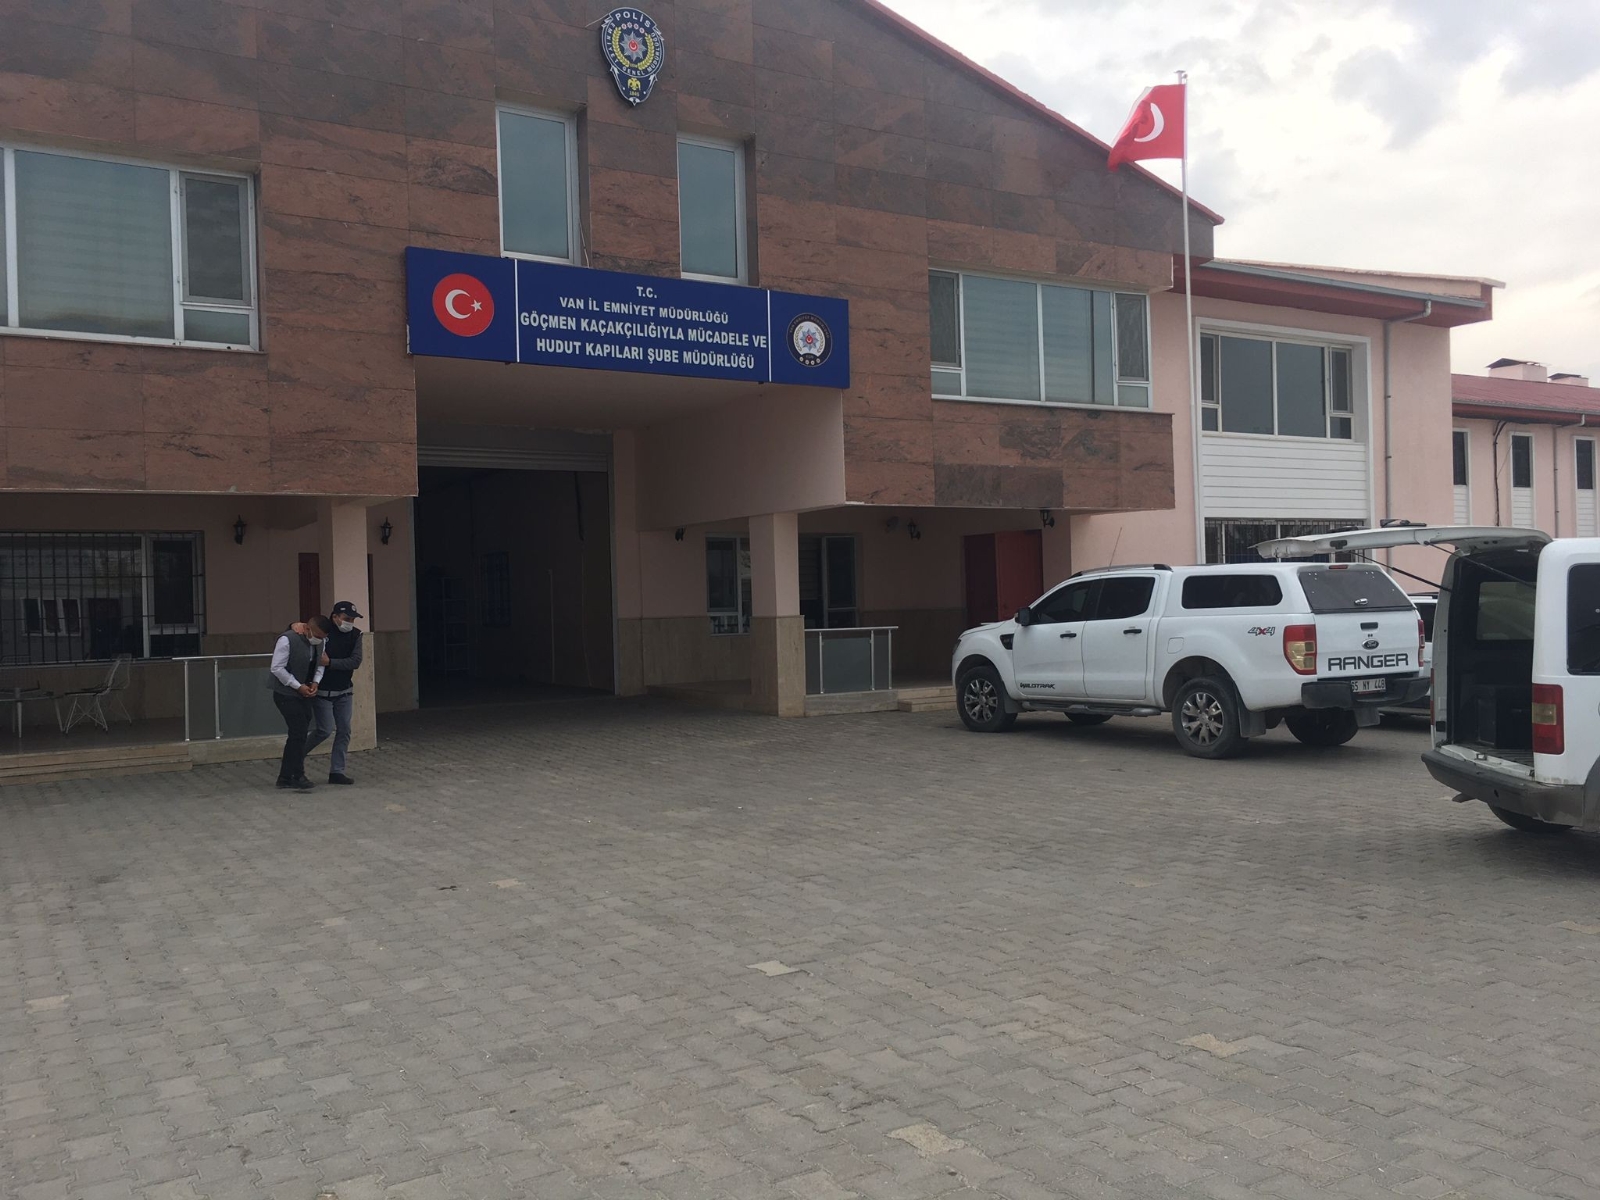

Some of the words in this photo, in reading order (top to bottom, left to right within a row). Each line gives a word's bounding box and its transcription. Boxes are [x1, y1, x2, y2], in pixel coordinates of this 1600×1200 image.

[636, 286, 658, 299] T.C.
[559, 296, 585, 310] VAN
[588, 297, 600, 312] İL
[603, 301, 656, 317] EMNİYET
[659, 306, 729, 324] MÜDÜRLÜĞÜ
[520, 310, 577, 331] GÖÇMEN
[580, 318, 685, 341] KAÇAKÇILIĞIYLA
[688, 327, 749, 347] MÜCADELE
[752, 335, 767, 348] VE
[536, 337, 582, 355] HUDUT
[585, 342, 644, 360] KAPILARI
[647, 347, 679, 364] ŞUBE
[683, 349, 755, 369] MÜDÜRLÜĞÜ
[1327, 653, 1409, 671] RANGER
